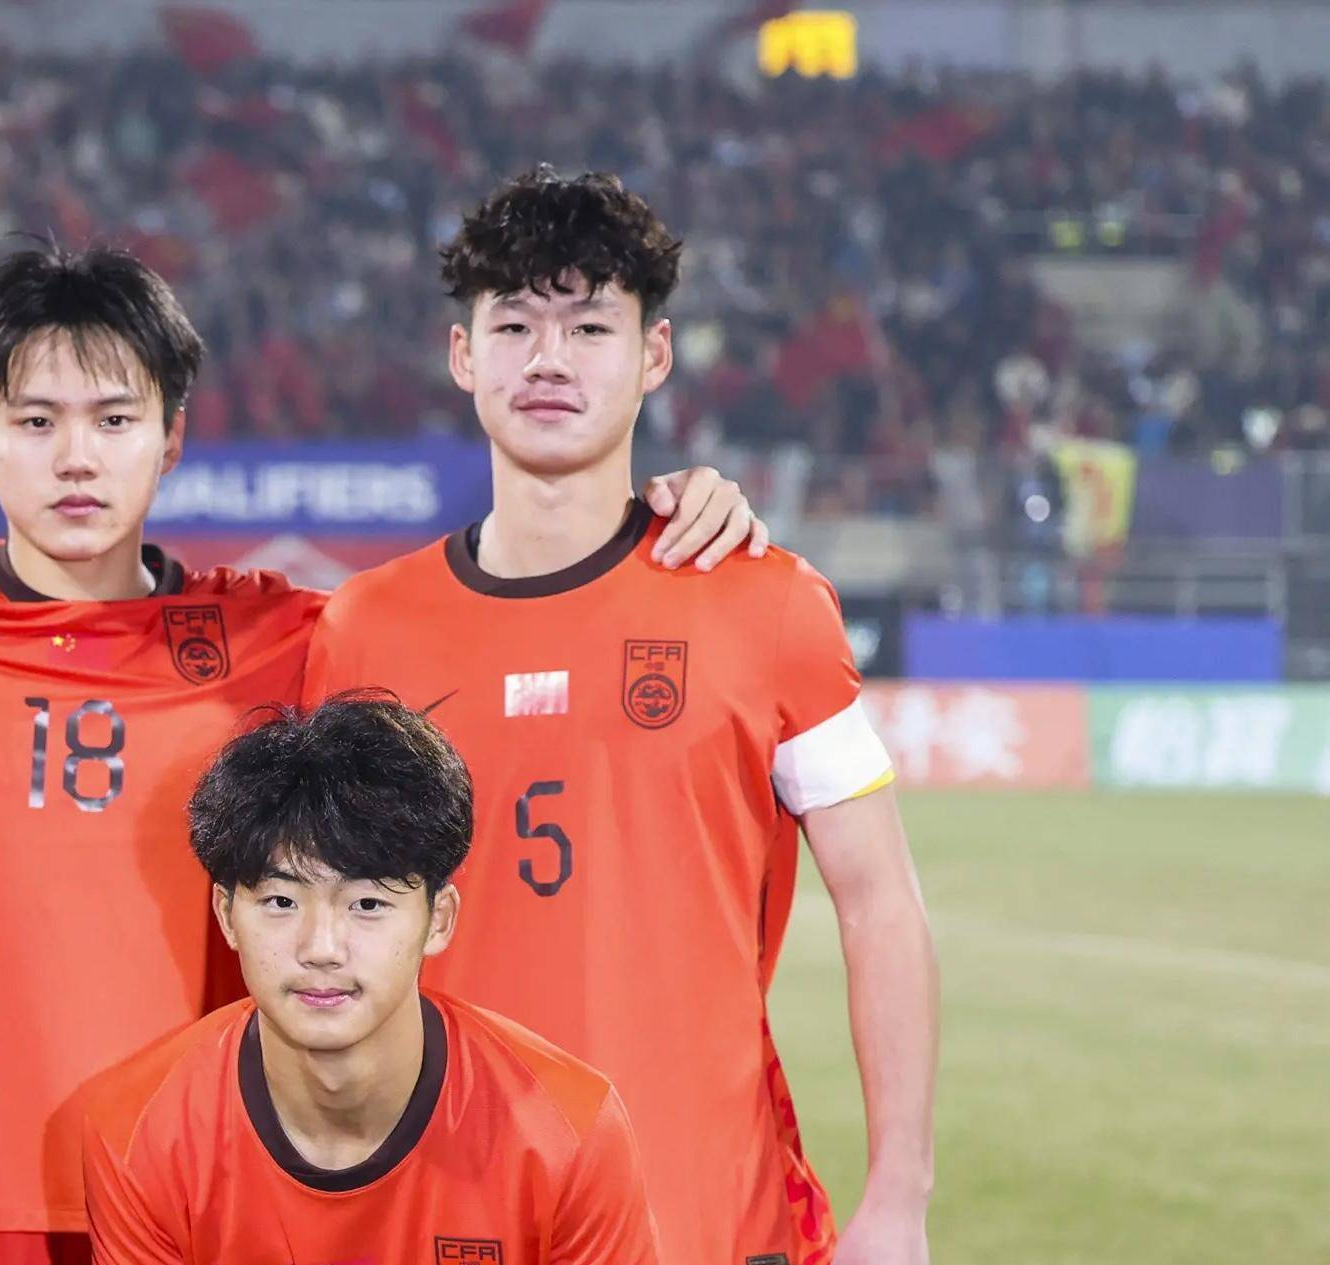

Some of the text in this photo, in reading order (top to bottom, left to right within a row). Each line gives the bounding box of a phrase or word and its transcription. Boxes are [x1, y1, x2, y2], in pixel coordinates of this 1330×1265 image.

[170, 611, 218, 625] CFA
[630, 646, 681, 661] CFA
[25, 697, 125, 812] 18
[516, 780, 572, 897] 5
[442, 1244, 496, 1261] CFA
